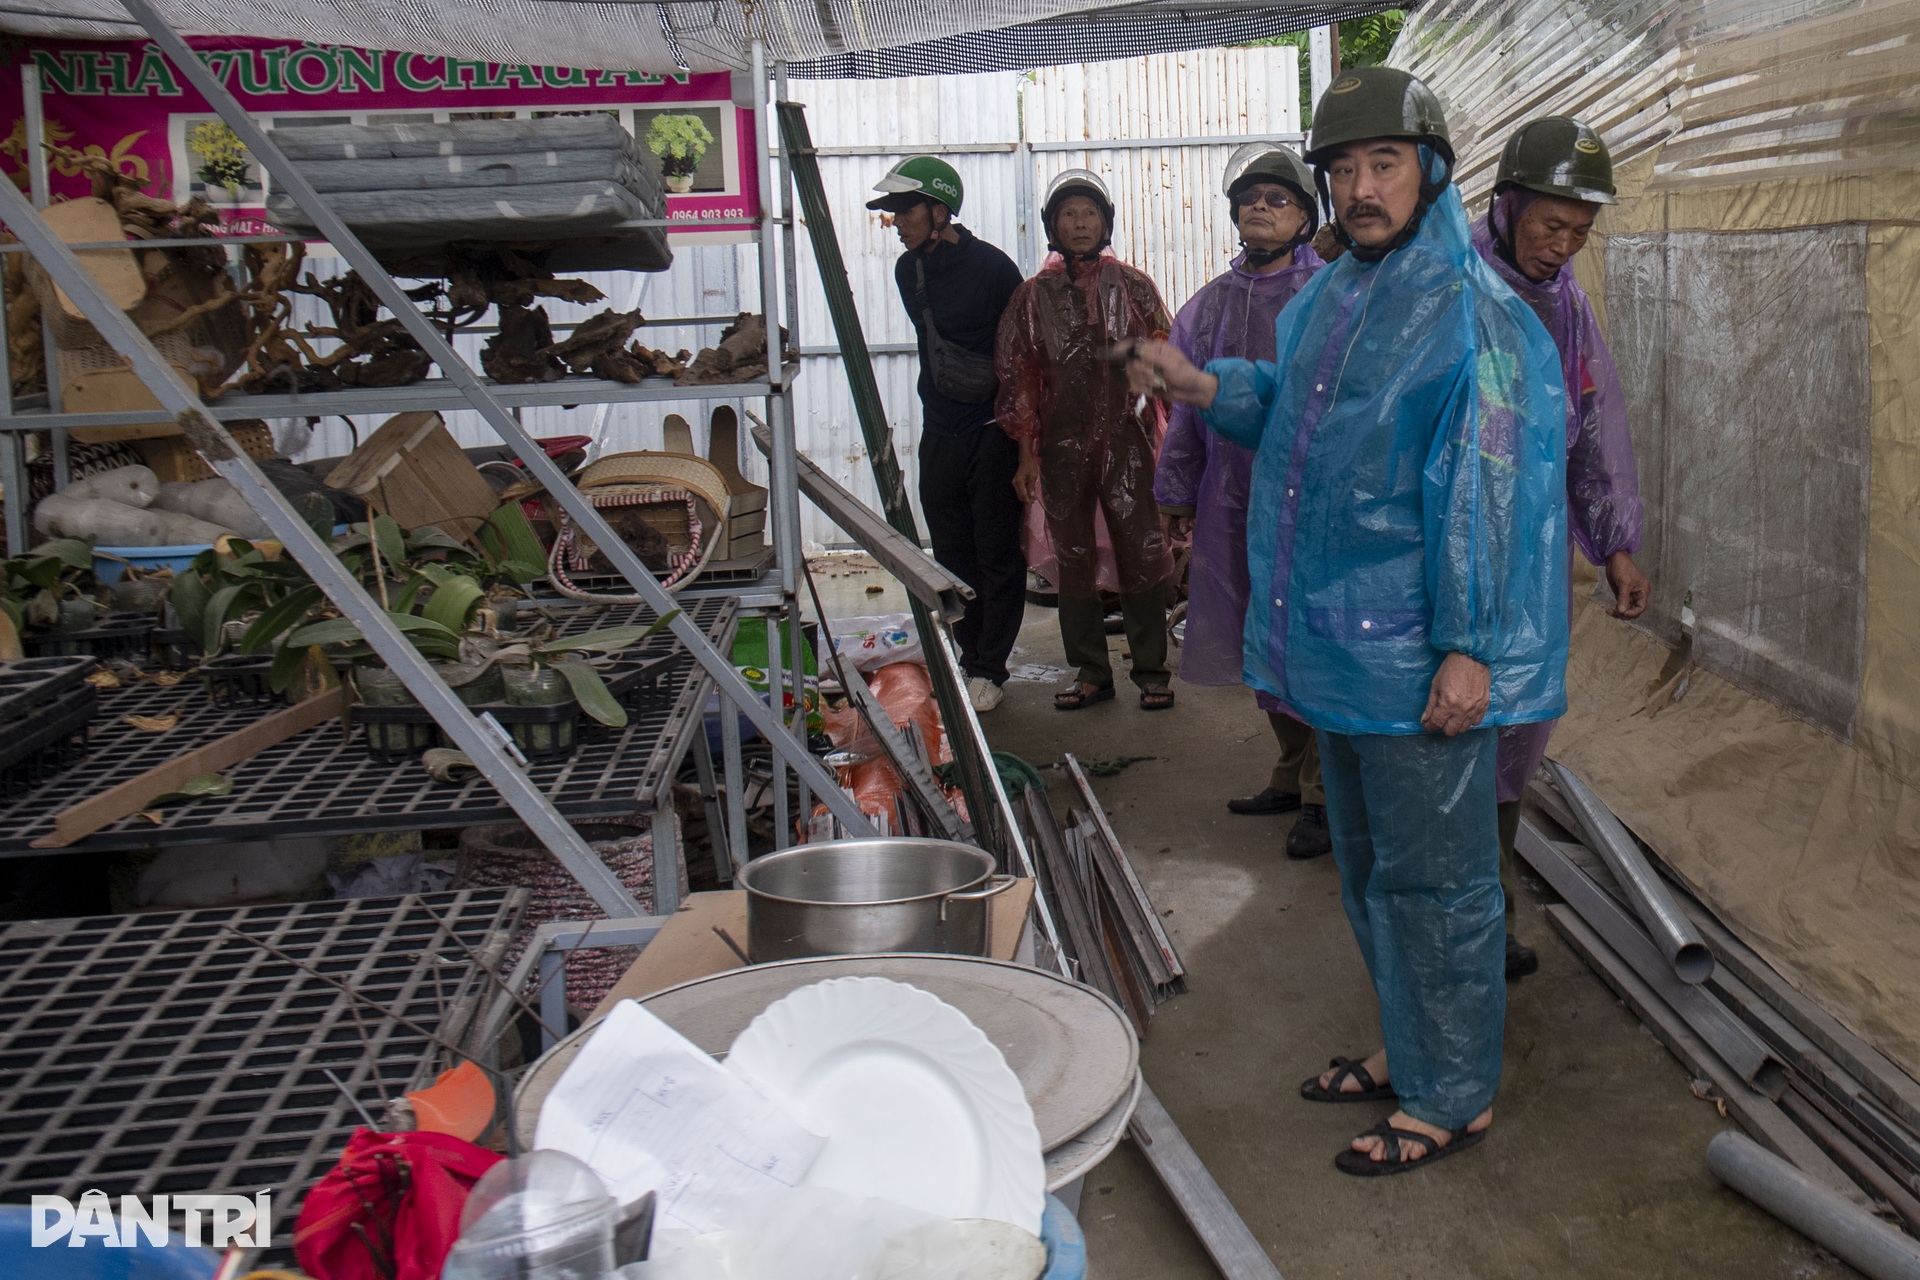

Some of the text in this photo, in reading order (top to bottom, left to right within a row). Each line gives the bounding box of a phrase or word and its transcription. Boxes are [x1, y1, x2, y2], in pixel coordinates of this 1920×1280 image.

[31, 44, 183, 97] NHÀ
[932, 178, 958, 198] Grab
[701, 208, 721, 219] 903
[723, 207, 744, 219] 993
